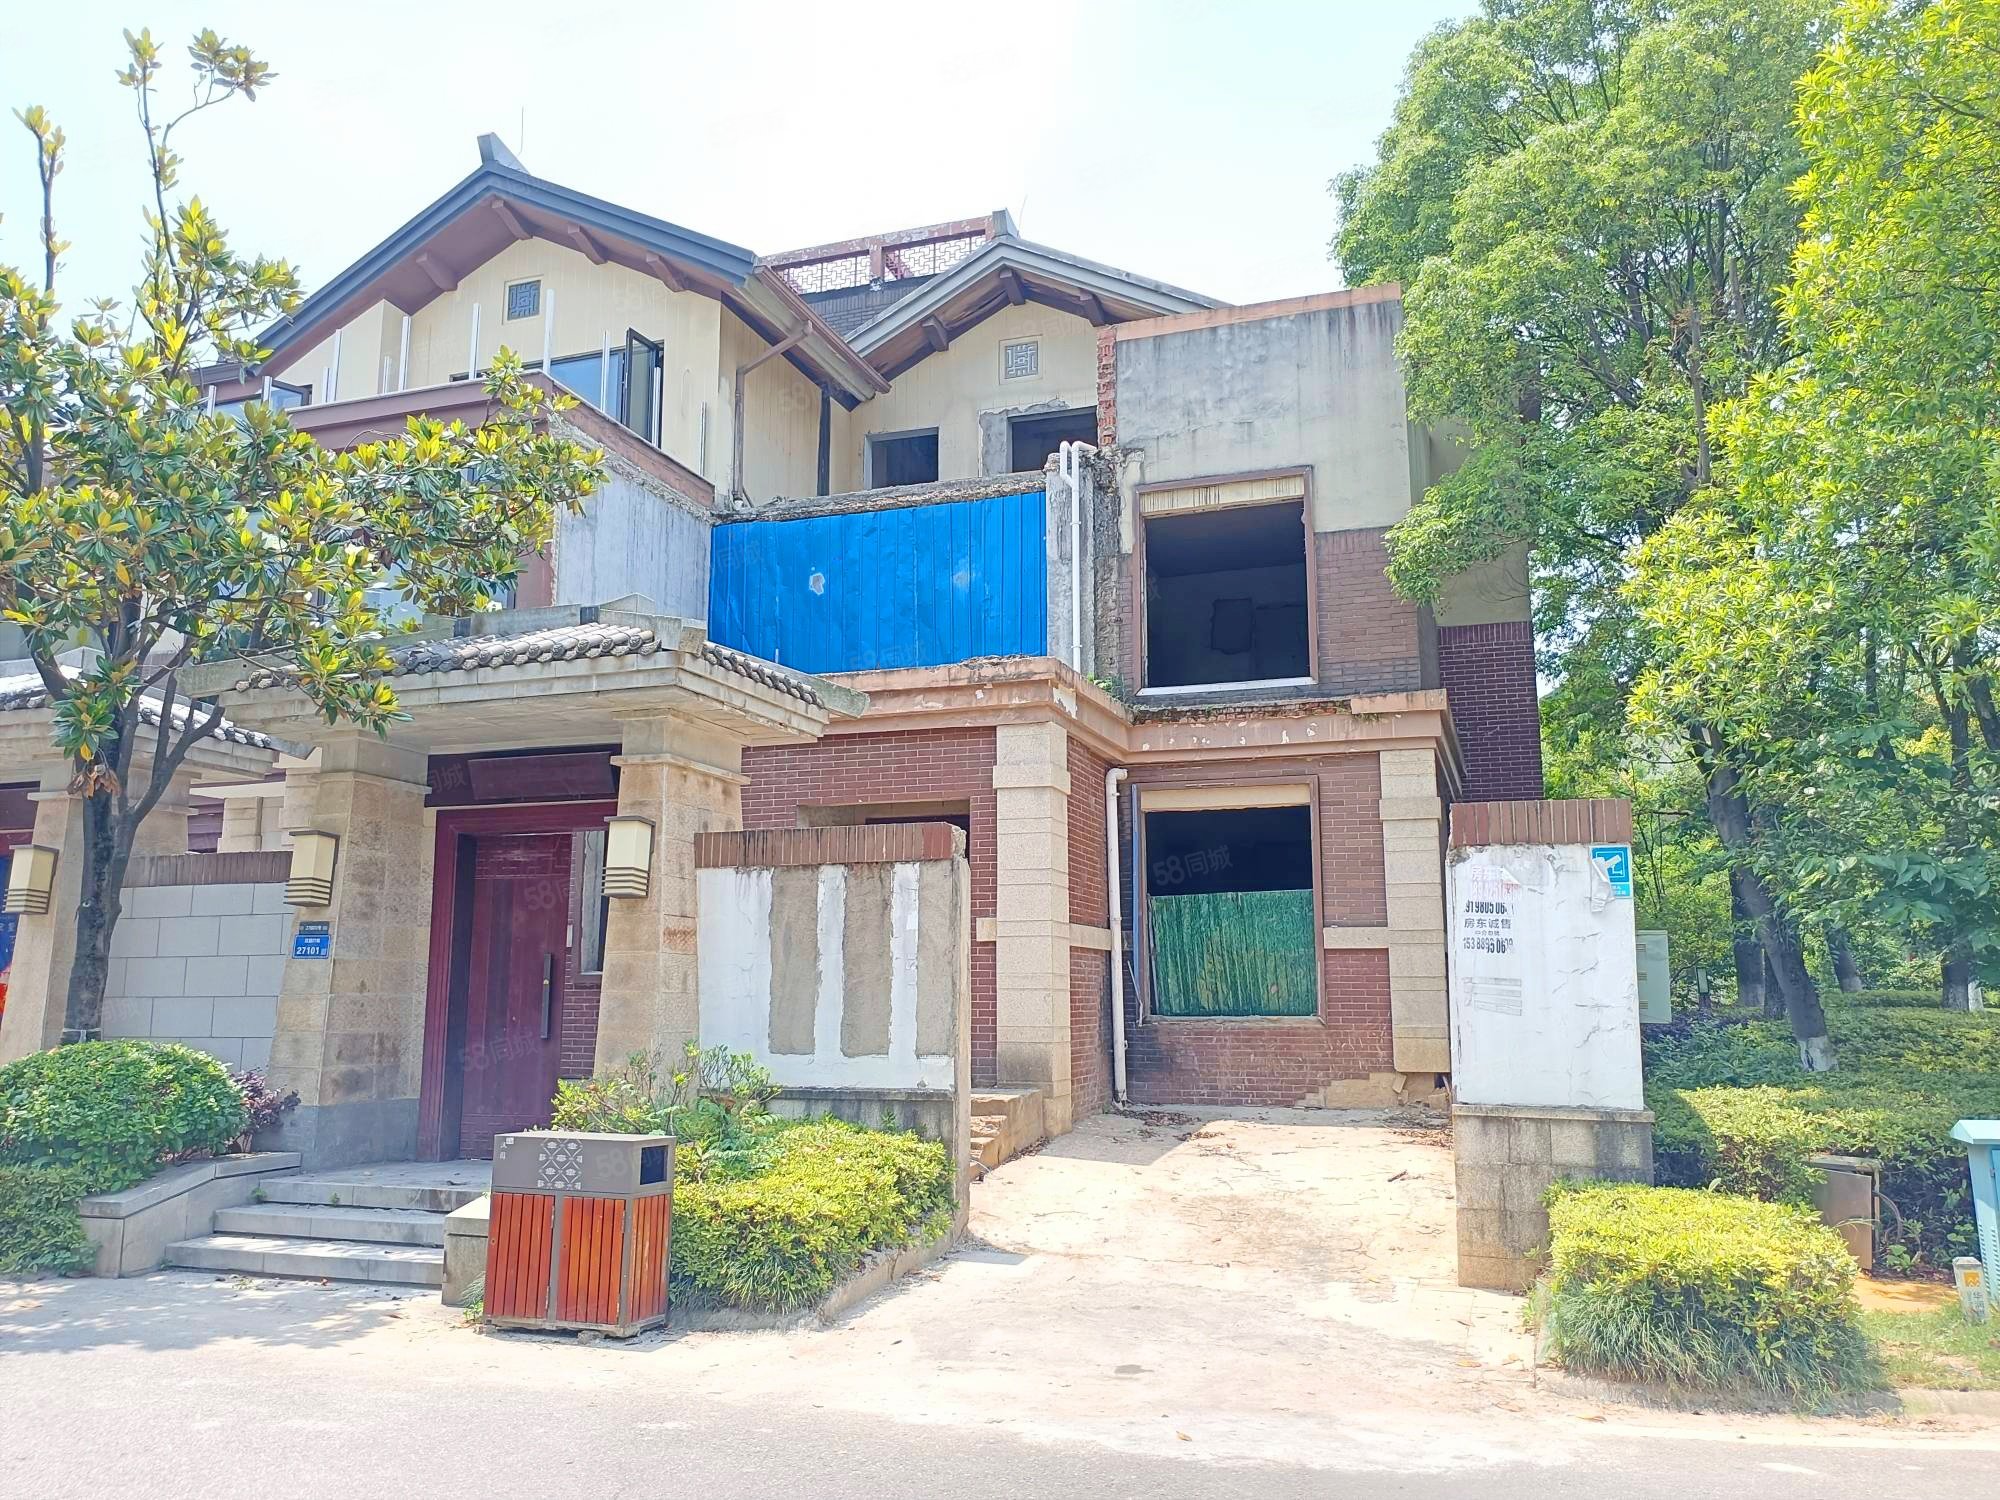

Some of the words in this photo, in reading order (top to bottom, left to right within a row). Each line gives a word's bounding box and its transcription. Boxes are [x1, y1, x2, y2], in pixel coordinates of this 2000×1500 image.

[1464, 918, 1512, 929] 房东诚售
[296, 946, 320, 955] 27101
